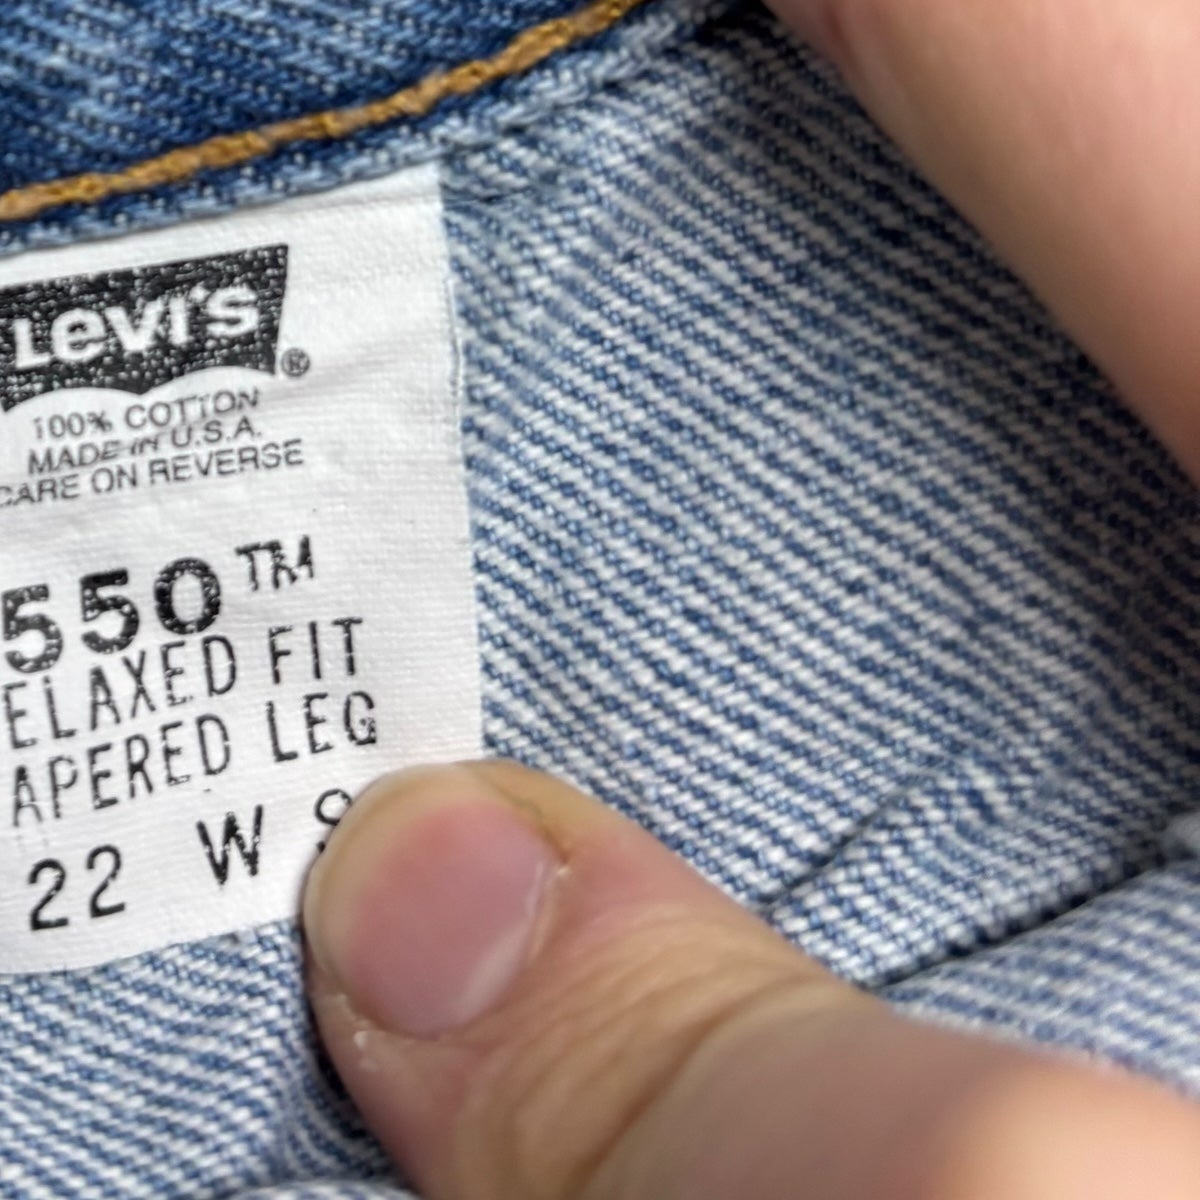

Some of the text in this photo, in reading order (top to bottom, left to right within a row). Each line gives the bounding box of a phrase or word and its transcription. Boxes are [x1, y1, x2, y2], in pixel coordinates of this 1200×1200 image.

[11, 284, 259, 369] Levi's
[28, 439, 120, 475] MADE
[170, 415, 262, 448] U.S.A.
[34, 387, 260, 439] 100% COTTON
[90, 464, 138, 493] ON
[149, 438, 305, 485] REVERSE
[267, 617, 363, 684] FIT
[266, 691, 378, 763] LEG
[27, 844, 126, 931] 22
[196, 805, 264, 886] W
